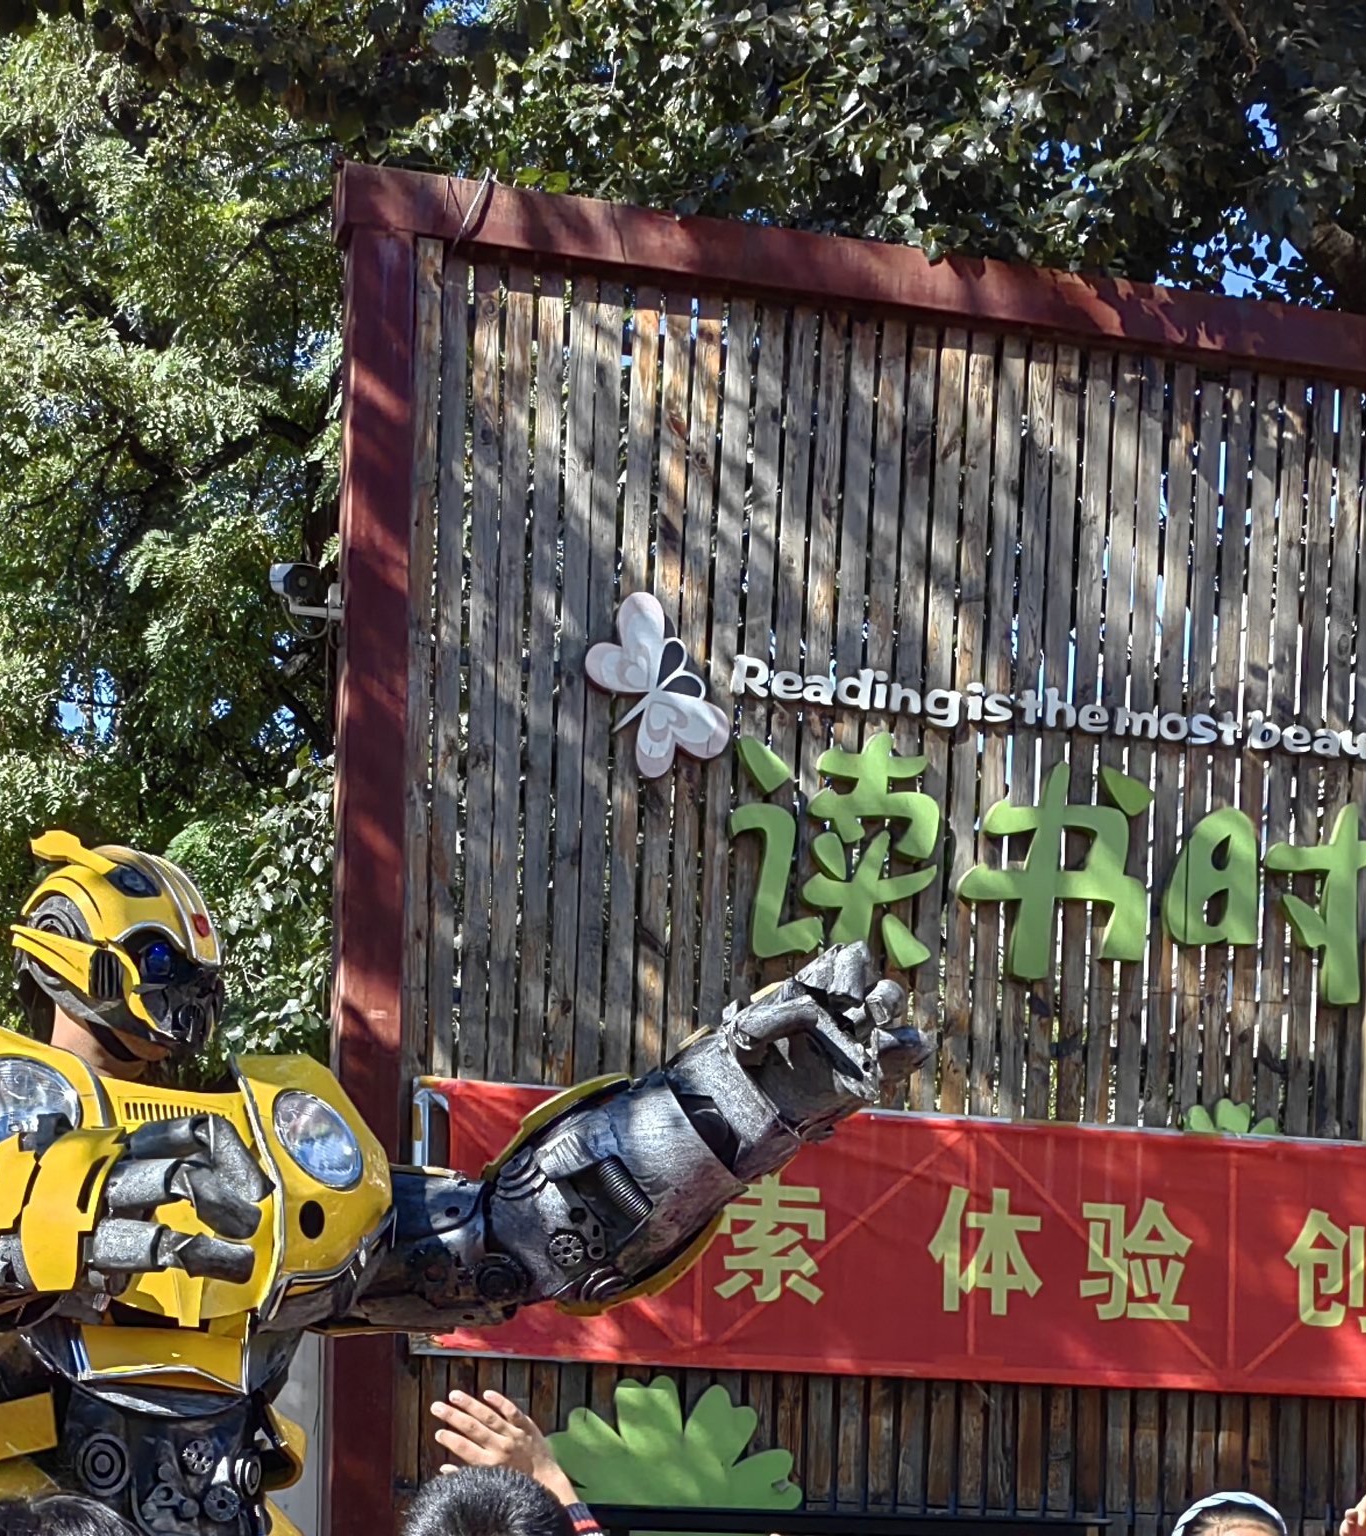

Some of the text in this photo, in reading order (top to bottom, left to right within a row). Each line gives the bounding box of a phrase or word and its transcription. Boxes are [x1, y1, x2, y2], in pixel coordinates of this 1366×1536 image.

[731, 654, 962, 728] Reading
[1015, 686, 1110, 733] the
[1114, 706, 1240, 746] most
[927, 1187, 1193, 1322] 体验
